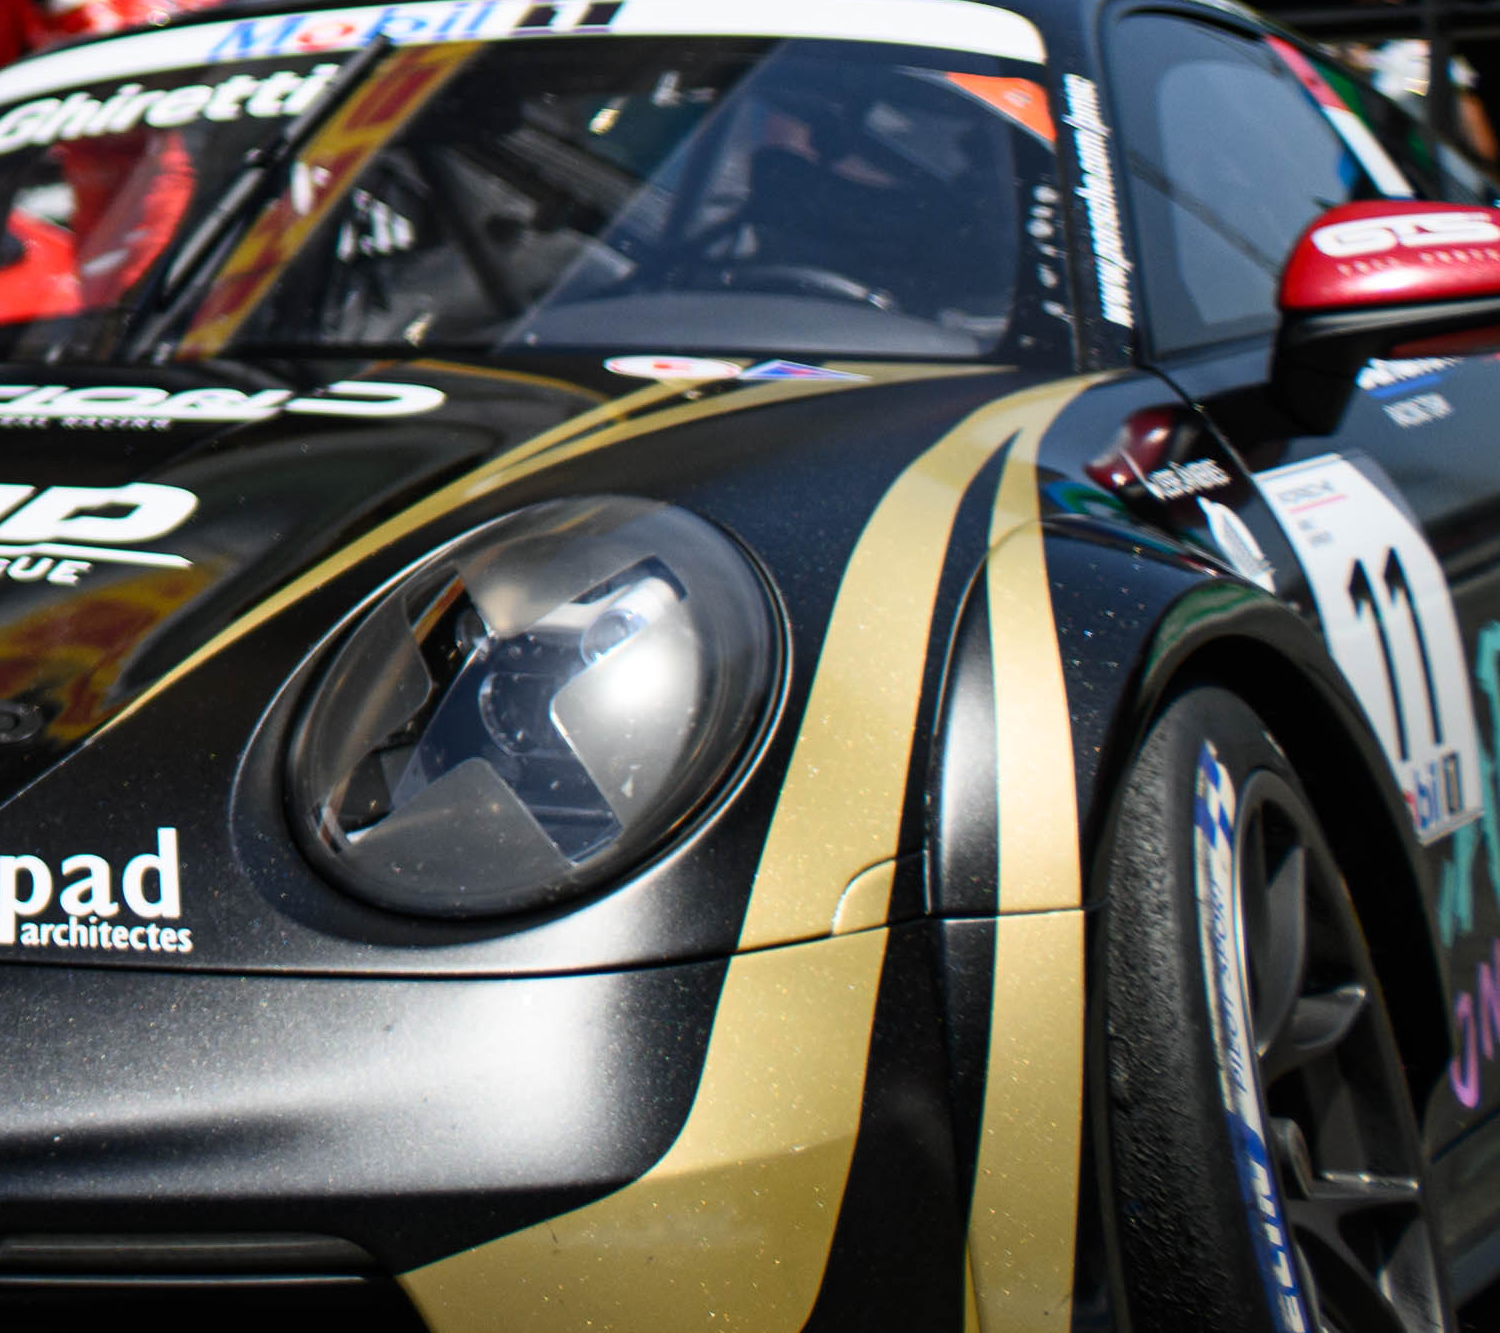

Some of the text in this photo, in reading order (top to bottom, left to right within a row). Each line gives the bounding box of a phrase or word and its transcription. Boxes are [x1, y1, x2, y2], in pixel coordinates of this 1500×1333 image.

[206, 0, 500, 64] Mobil
[1347, 546, 1444, 763] 11
[21, 914, 193, 953] architectes
